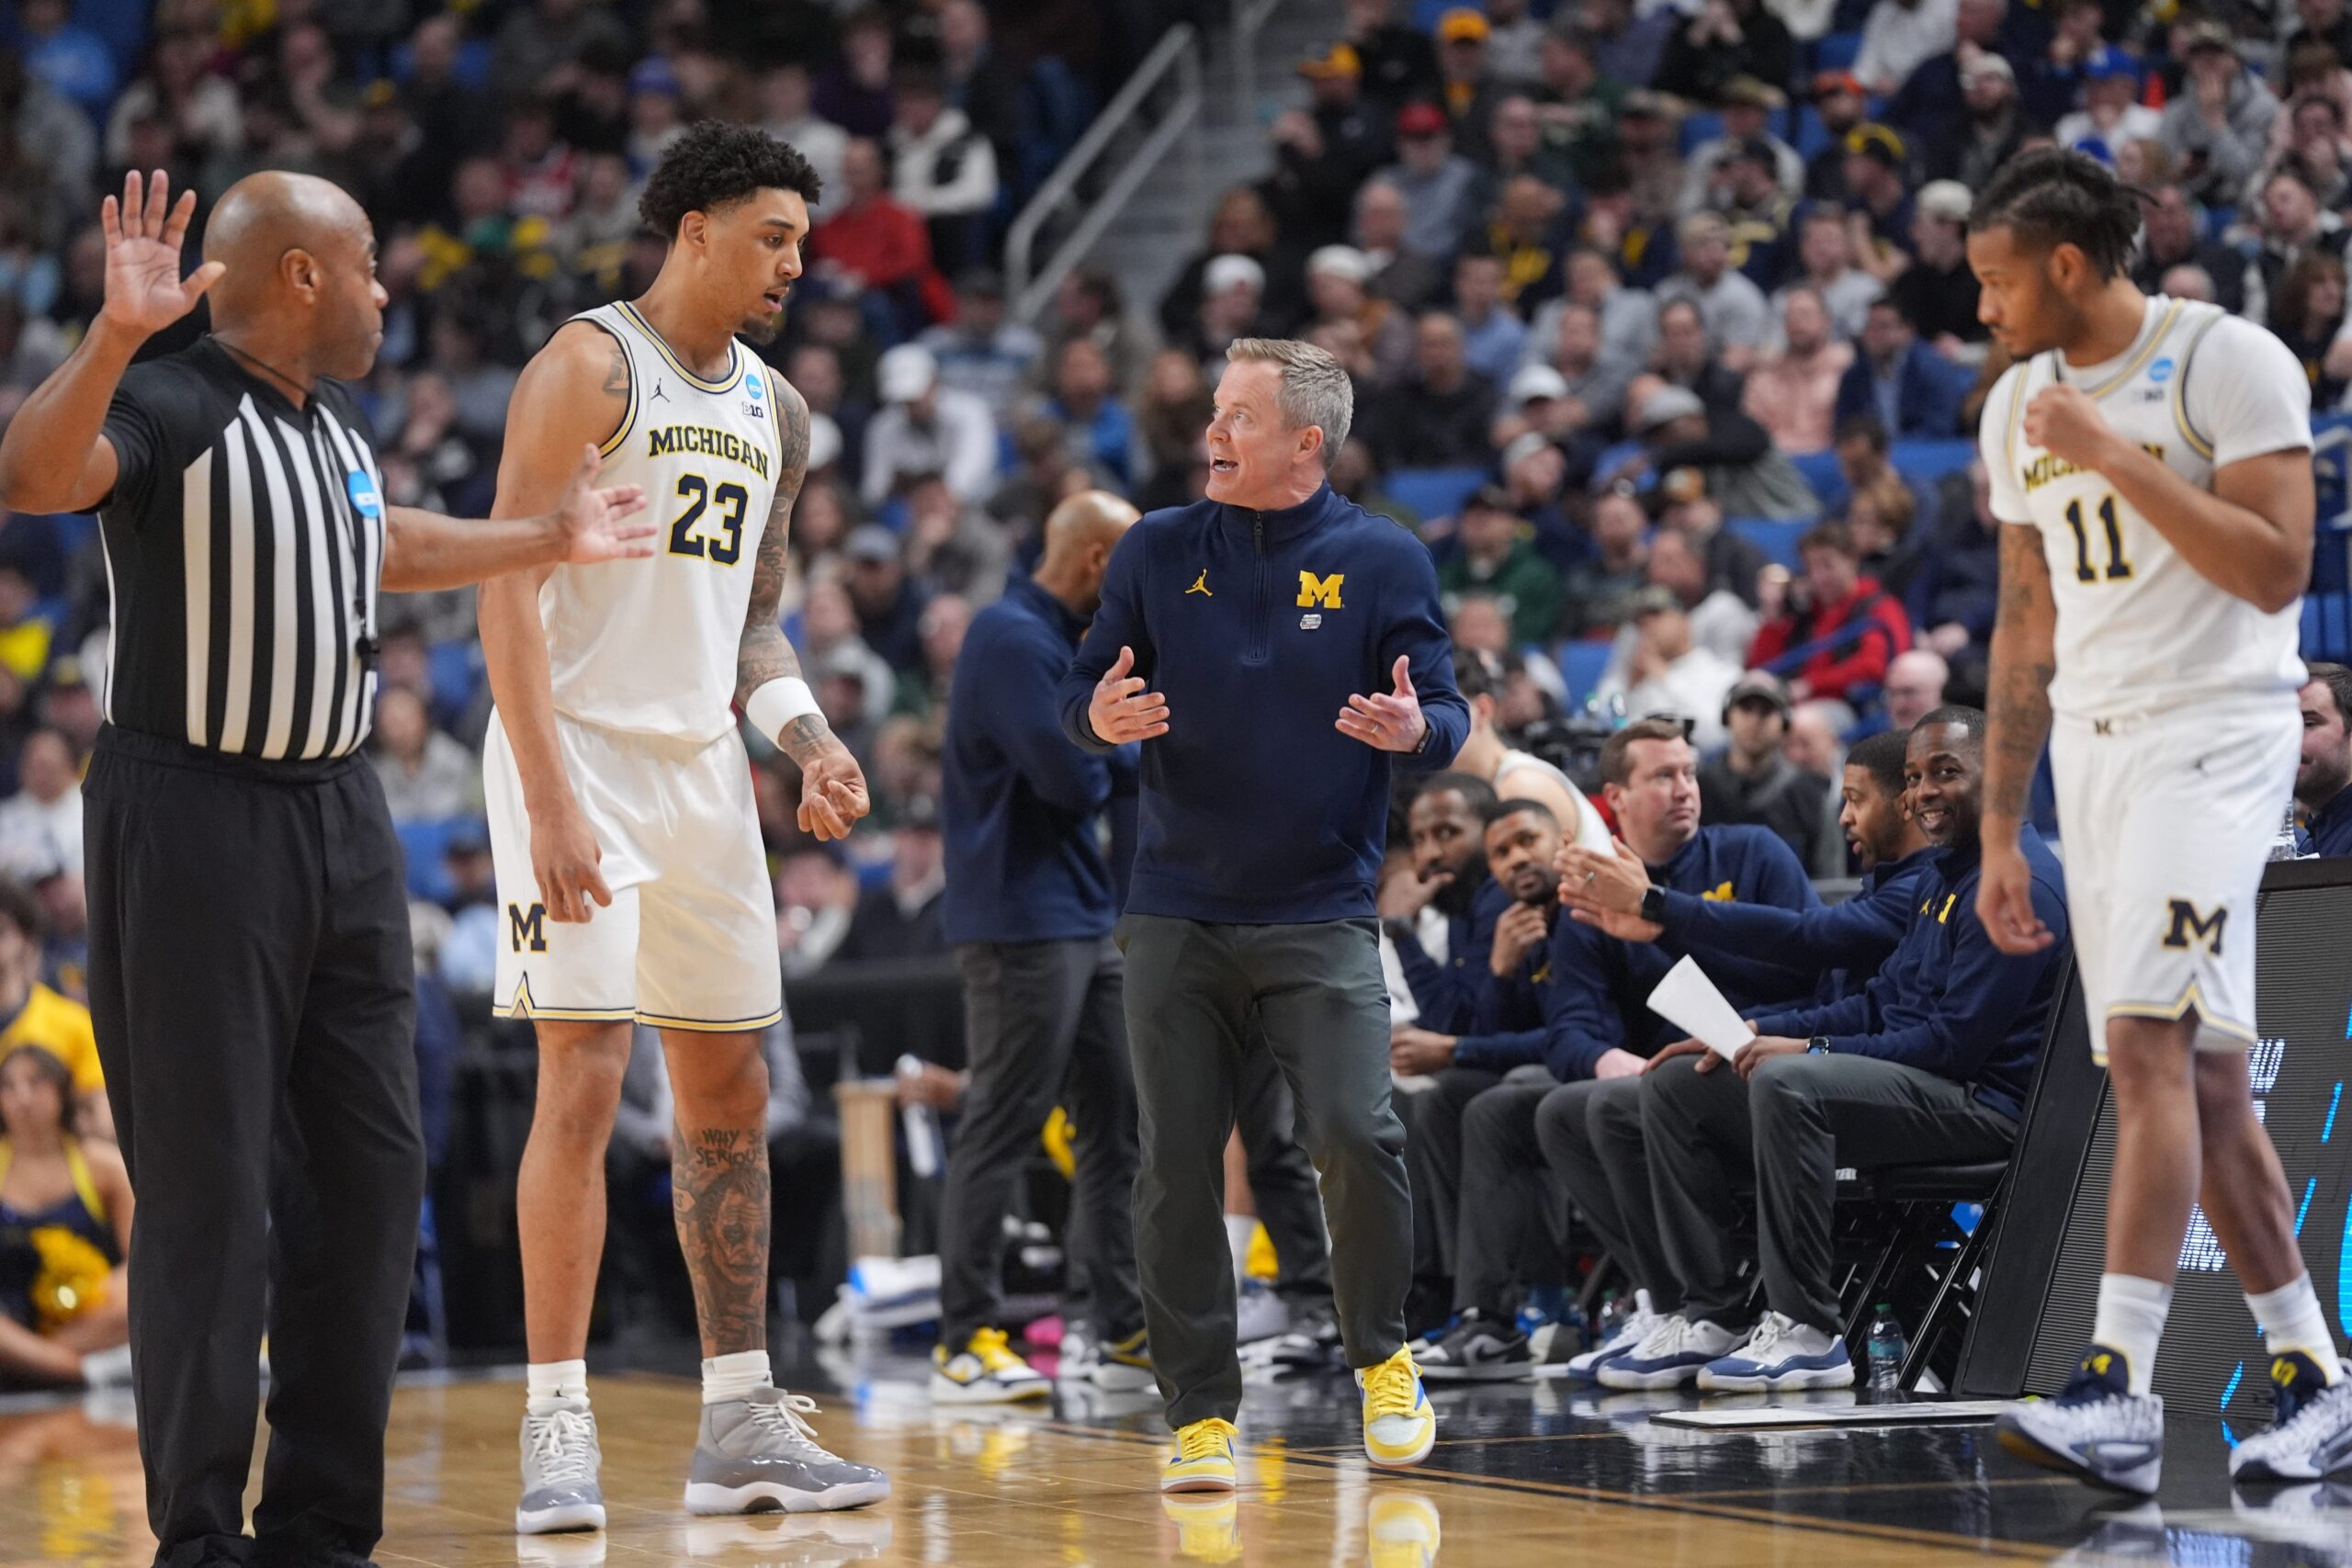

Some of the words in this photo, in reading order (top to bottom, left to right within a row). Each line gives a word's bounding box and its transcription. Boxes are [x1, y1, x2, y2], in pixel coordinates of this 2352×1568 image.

[648, 425, 769, 481] MICHIGAN
[668, 473, 749, 566] 23
[2064, 494, 2133, 583] 11
[1296, 570, 1345, 609] M
[508, 901, 548, 953] M
[2162, 898, 2228, 957] M
[702, 1128, 740, 1149] WHY
